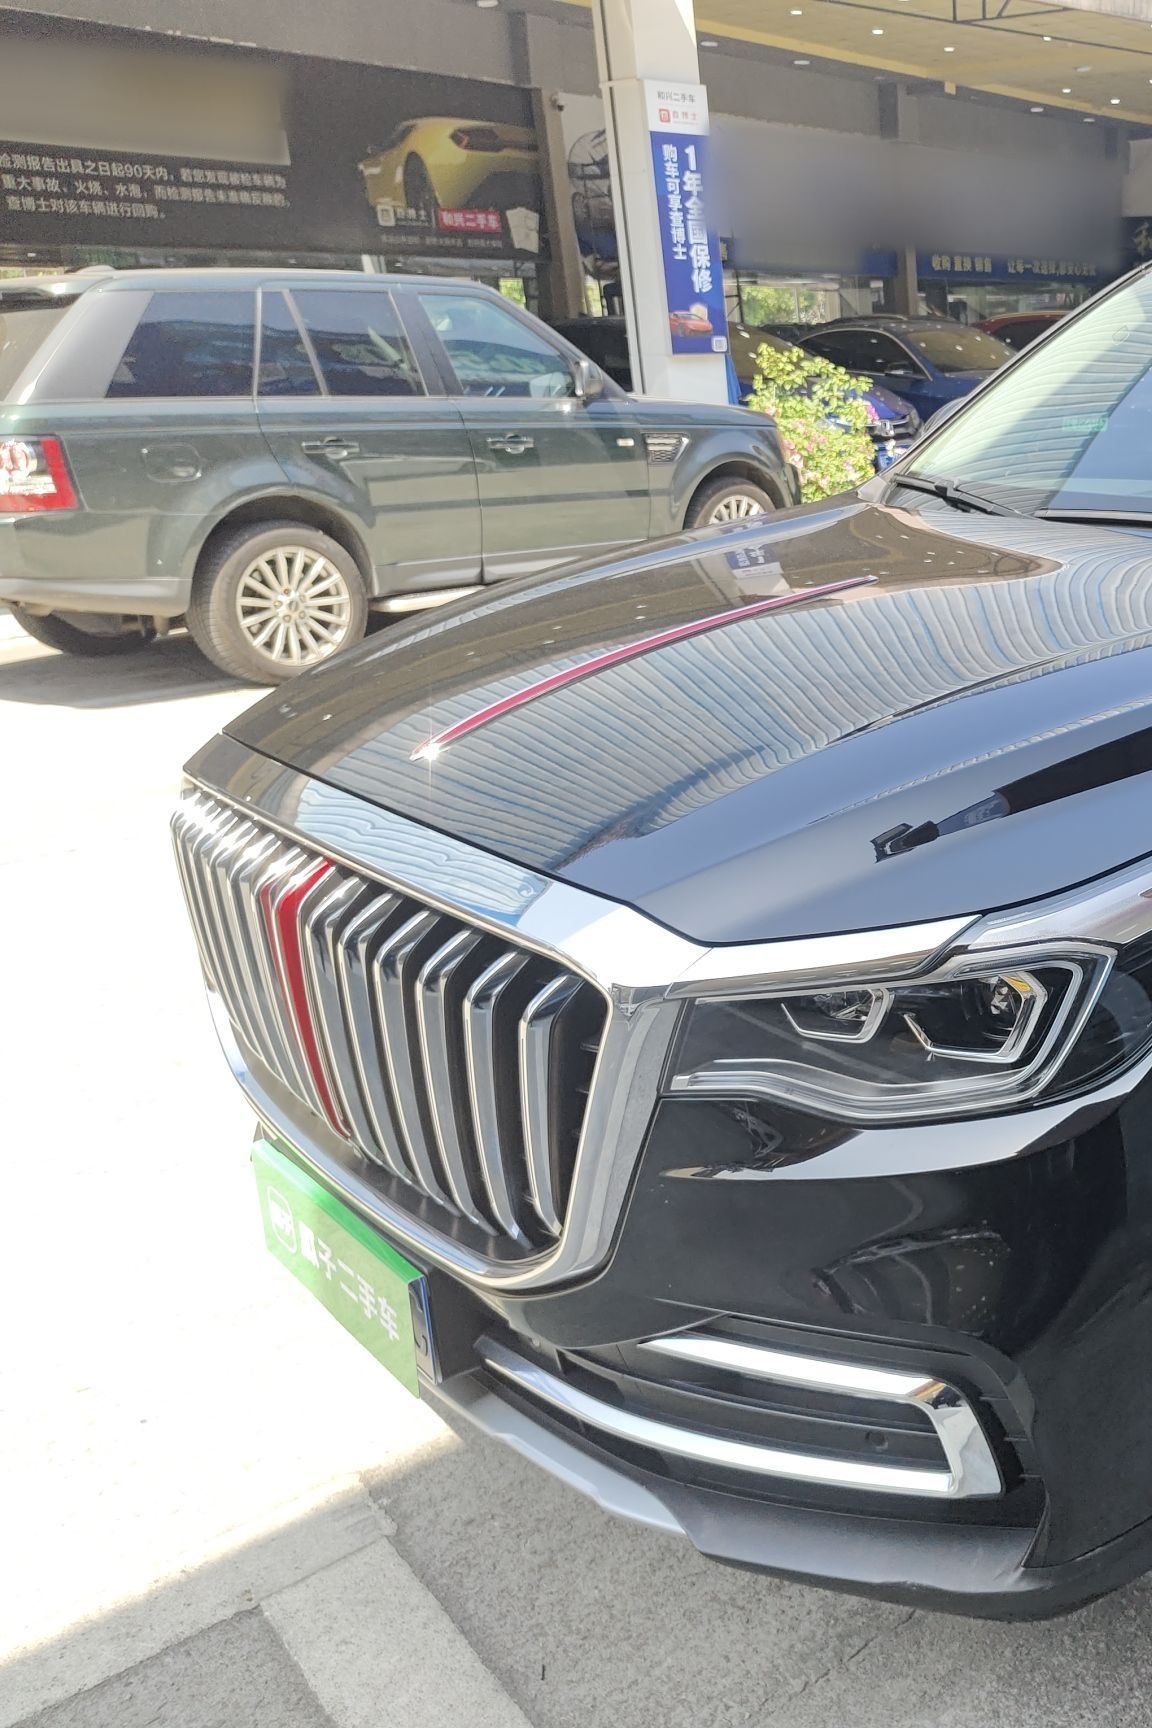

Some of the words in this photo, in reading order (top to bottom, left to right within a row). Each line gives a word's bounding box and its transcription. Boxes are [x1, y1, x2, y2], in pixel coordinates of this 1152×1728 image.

[661, 143, 688, 260] 购车可享查博士
[683, 144, 713, 294] 1年全国保修
